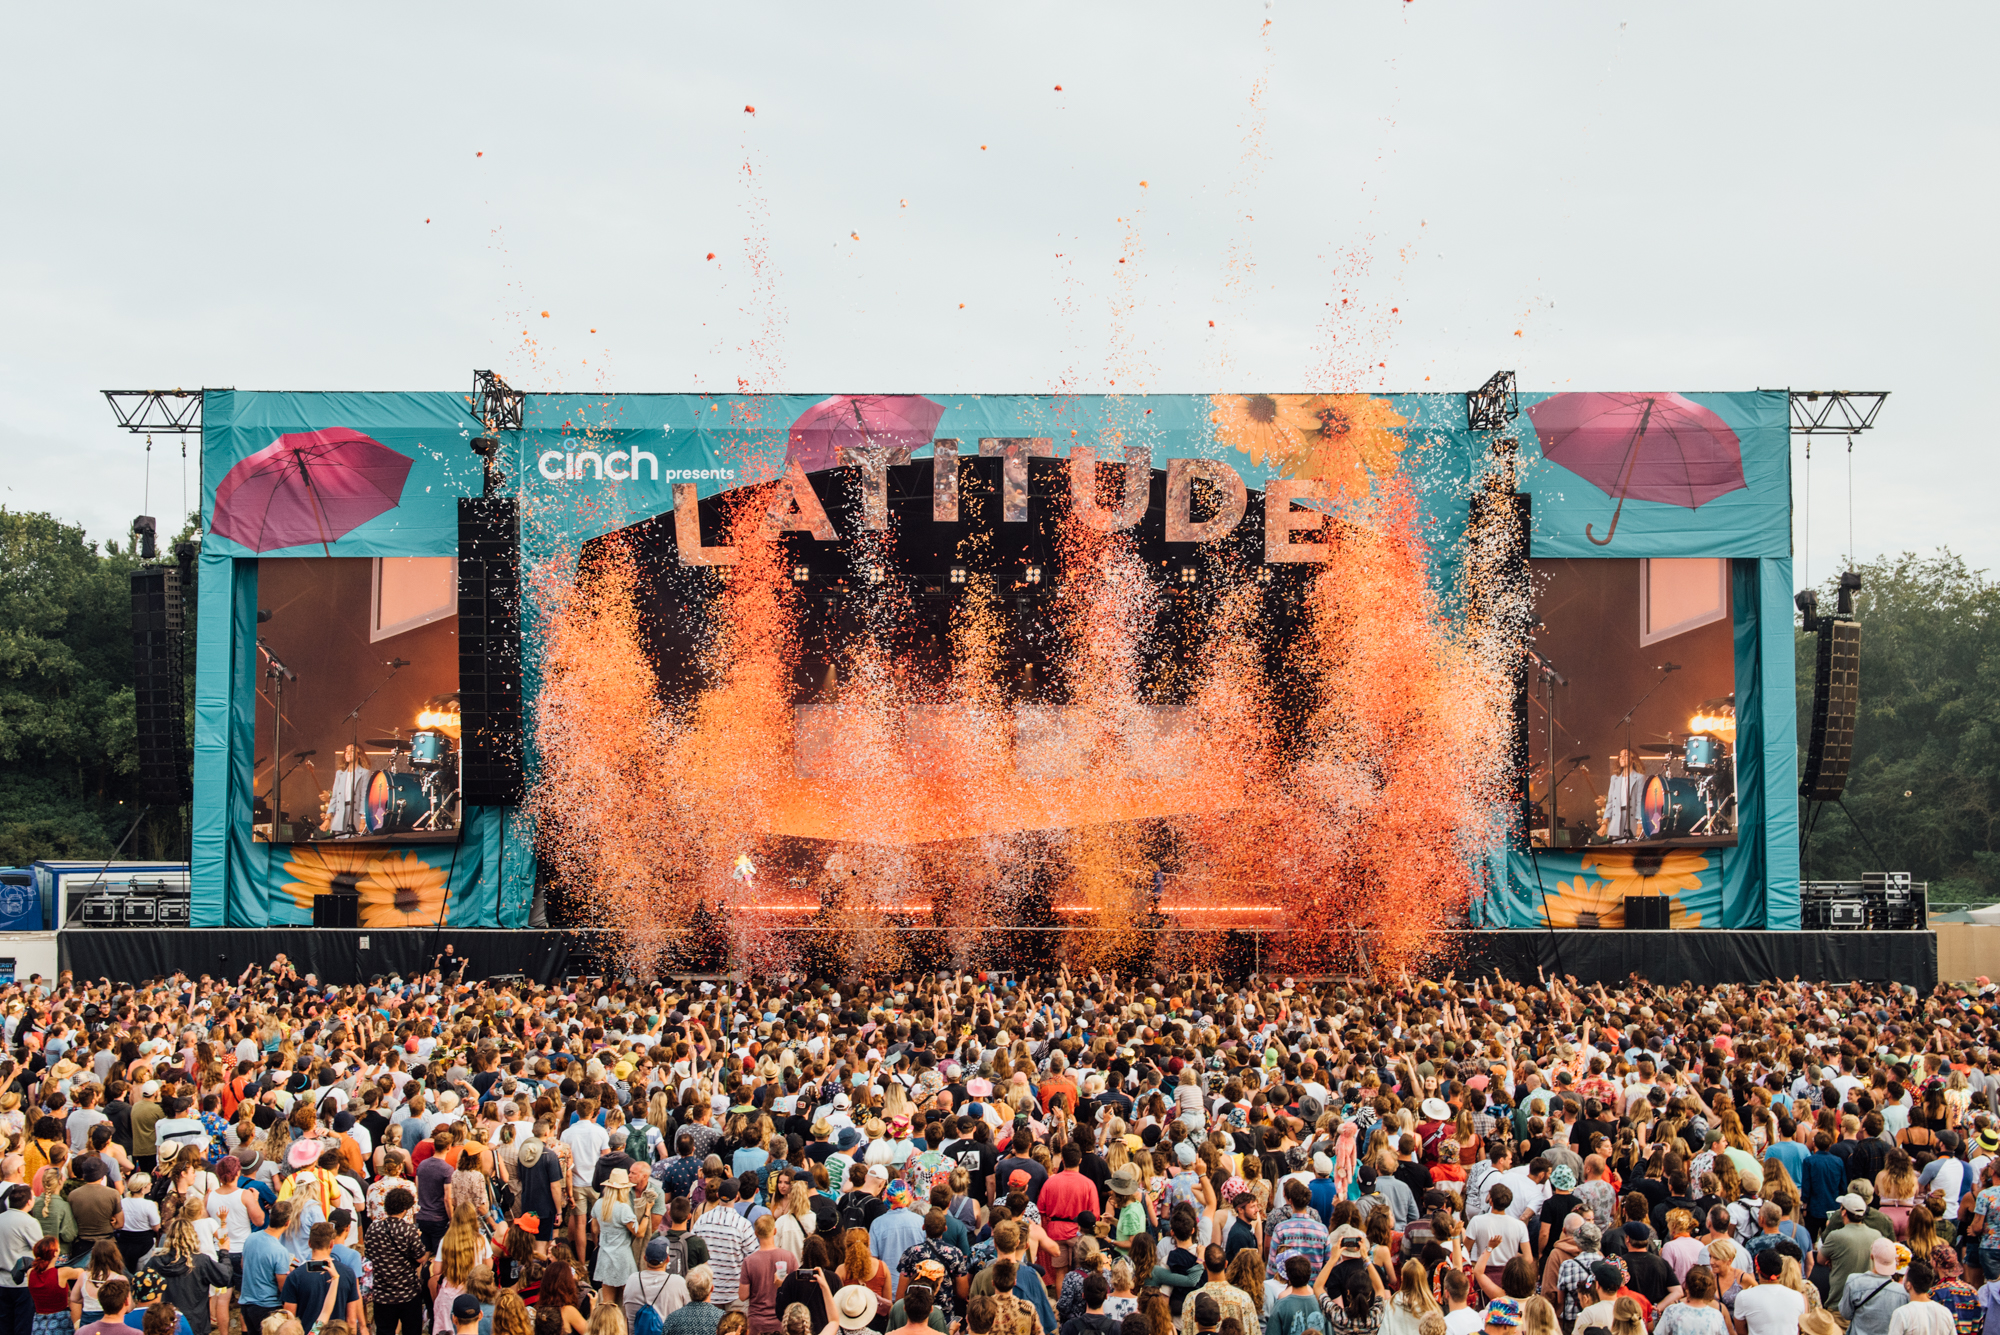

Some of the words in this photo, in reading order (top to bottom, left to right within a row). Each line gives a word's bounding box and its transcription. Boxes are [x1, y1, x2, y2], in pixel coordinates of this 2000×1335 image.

[538, 438, 659, 481] cinch
[666, 468, 735, 484] presents
[672, 437, 1330, 567] LATITUDE
